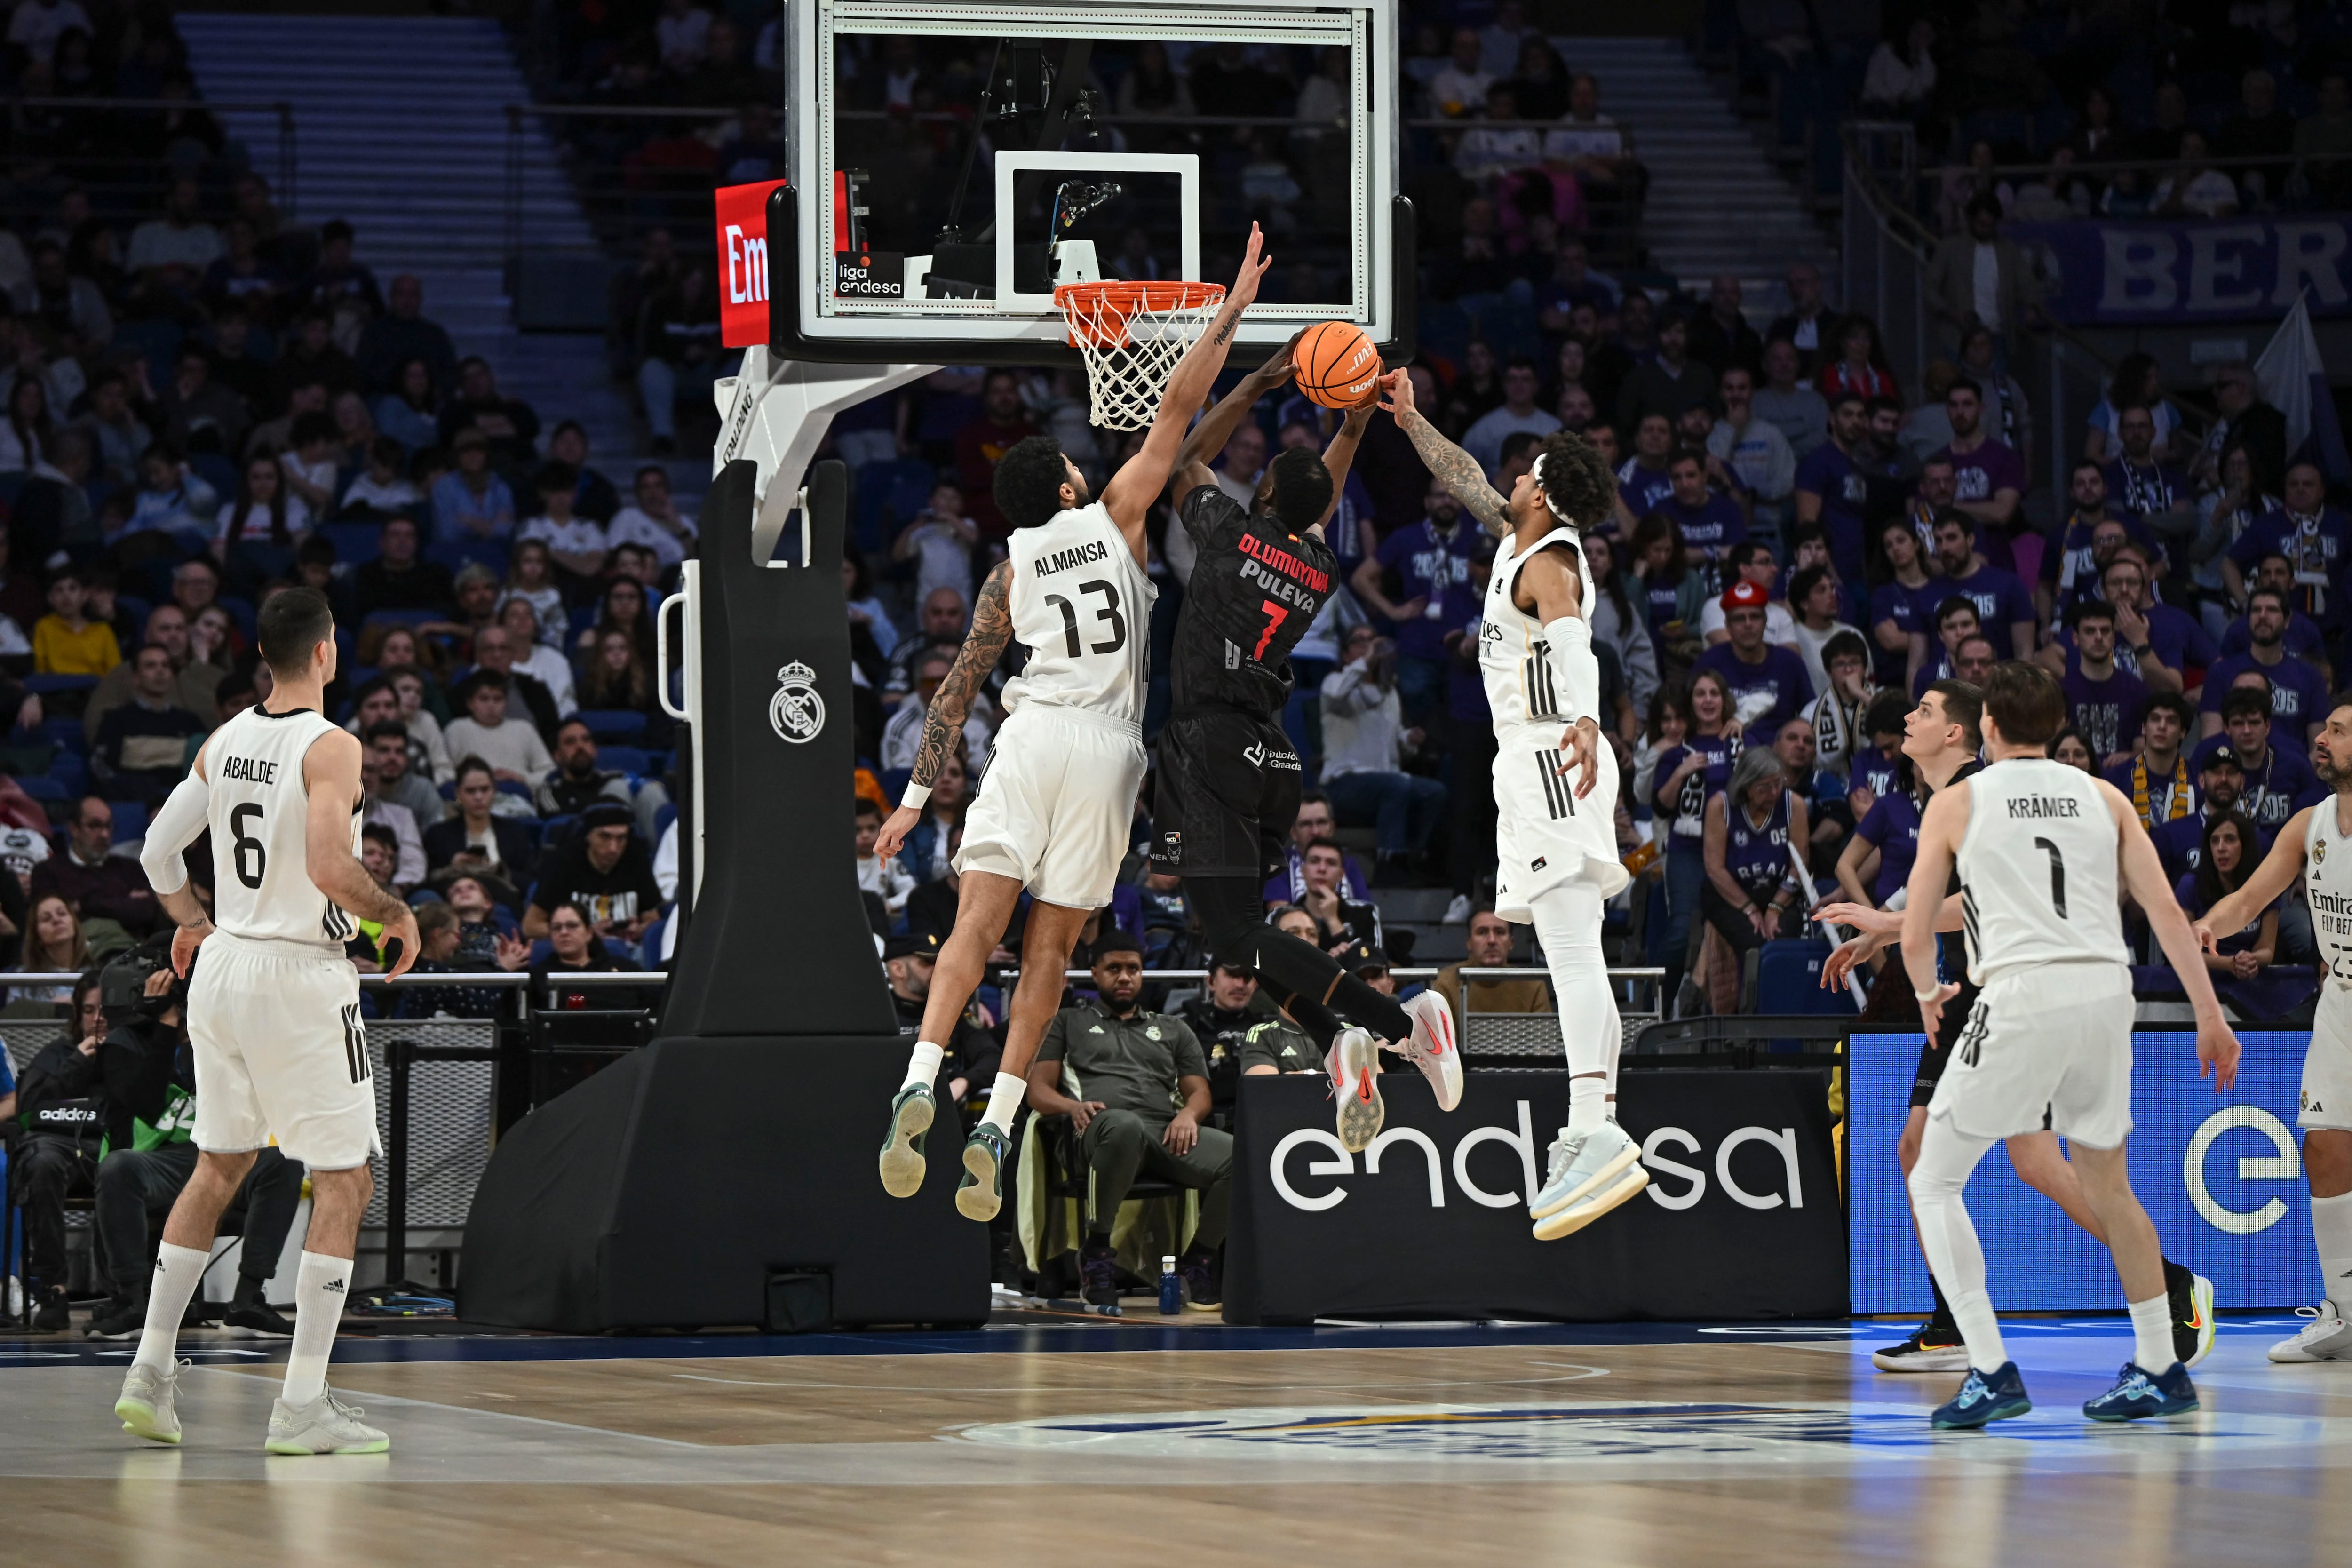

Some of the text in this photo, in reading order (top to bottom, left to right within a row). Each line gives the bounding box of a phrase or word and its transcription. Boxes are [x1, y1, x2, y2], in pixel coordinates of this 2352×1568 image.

[839, 264, 867, 281] liga
[839, 279, 901, 294] endesa
[1034, 541, 1108, 578] ALMANSA
[1239, 558, 1315, 614] PULEVA
[1044, 579, 1126, 658] 13
[1253, 599, 1289, 662] 7
[223, 756, 278, 785] ABALDE
[2007, 793, 2080, 818] KRÄMER
[230, 802, 266, 889] 6
[1533, 862, 1543, 871] acb
[2034, 836, 2068, 920] 1
[2322, 915, 2334, 932] FLY
[39, 1107, 97, 1121] adidas
[1269, 1099, 1804, 1211] endsa
[2185, 1105, 2300, 1235] e
[322, 1282, 345, 1295] adidas
